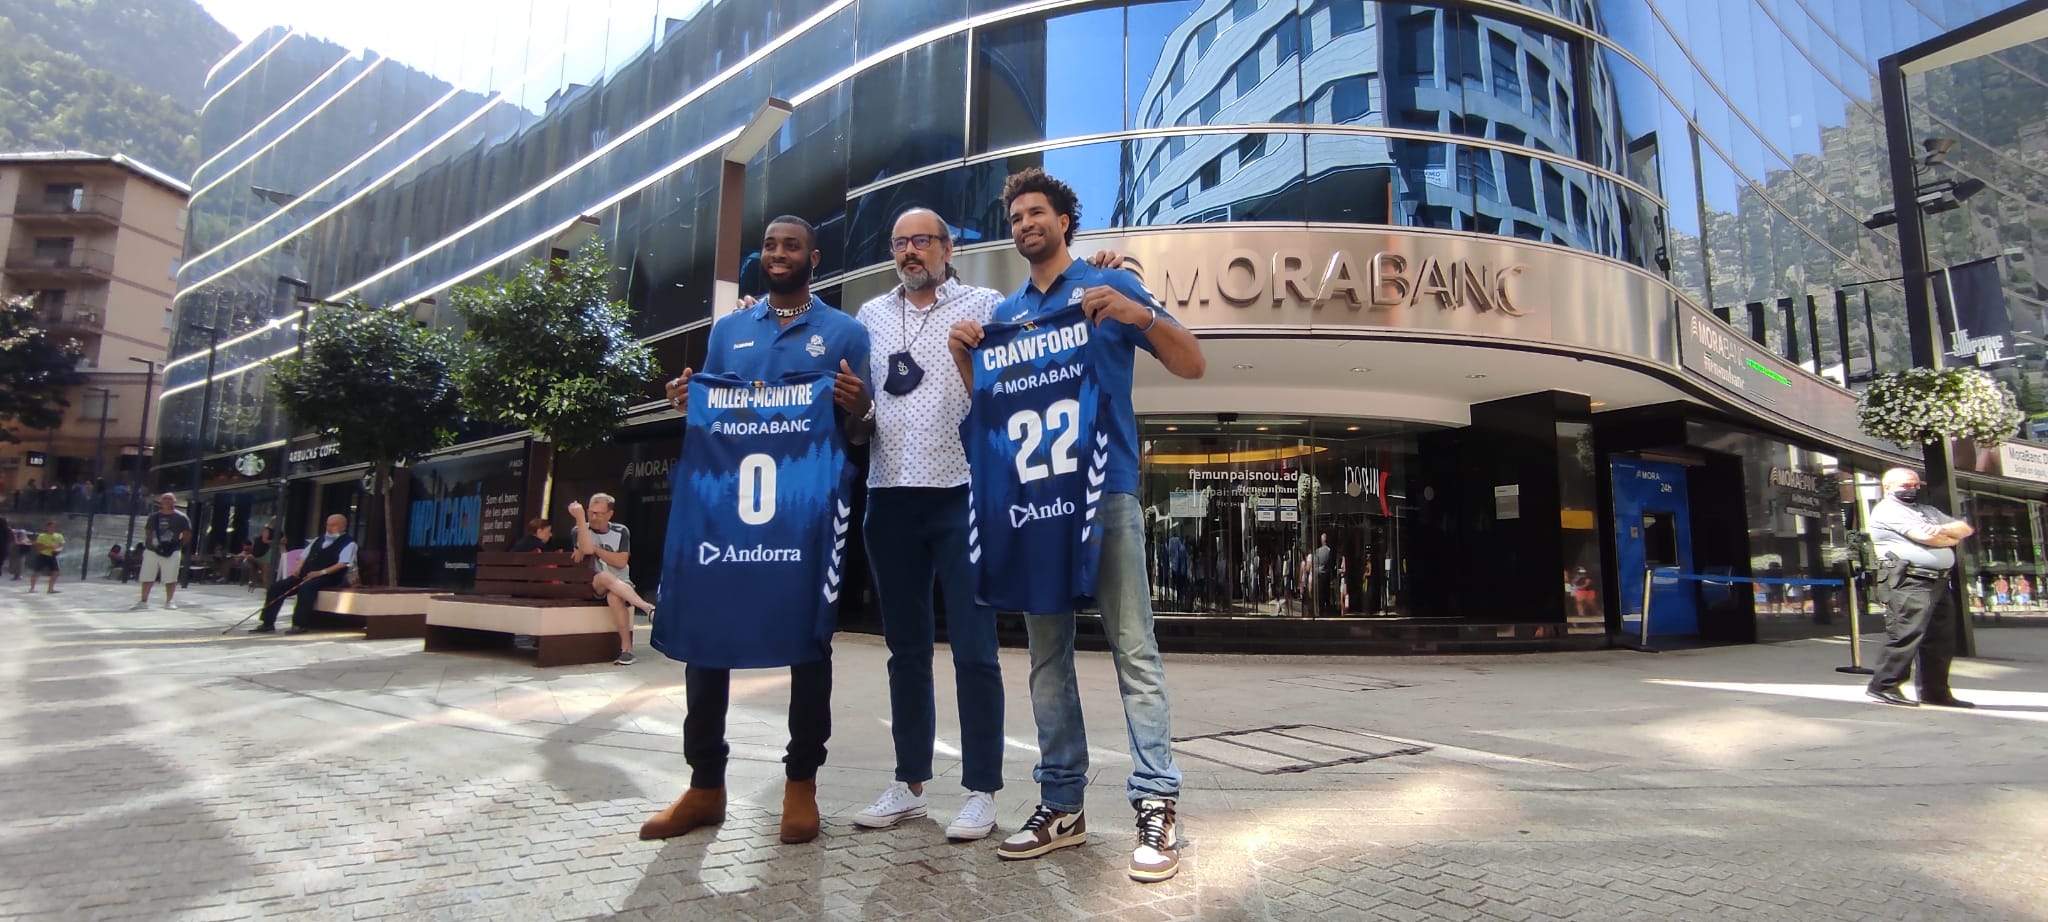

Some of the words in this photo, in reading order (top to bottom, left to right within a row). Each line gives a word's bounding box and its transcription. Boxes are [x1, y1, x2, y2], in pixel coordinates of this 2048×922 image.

[1155, 248, 1536, 317] MORABANC
[983, 322, 1089, 370] CRAWFORD
[1698, 320, 1746, 370] MORABANC
[708, 384, 813, 409] MILLER-MCINTYRE
[1005, 363, 1084, 394] MORABAN
[723, 419, 811, 435] MORABANC
[1008, 399, 1080, 484] 22
[738, 453, 776, 525] 0
[1188, 468, 1299, 483] femunpaisnou.ad
[722, 544, 801, 562] Andorra
